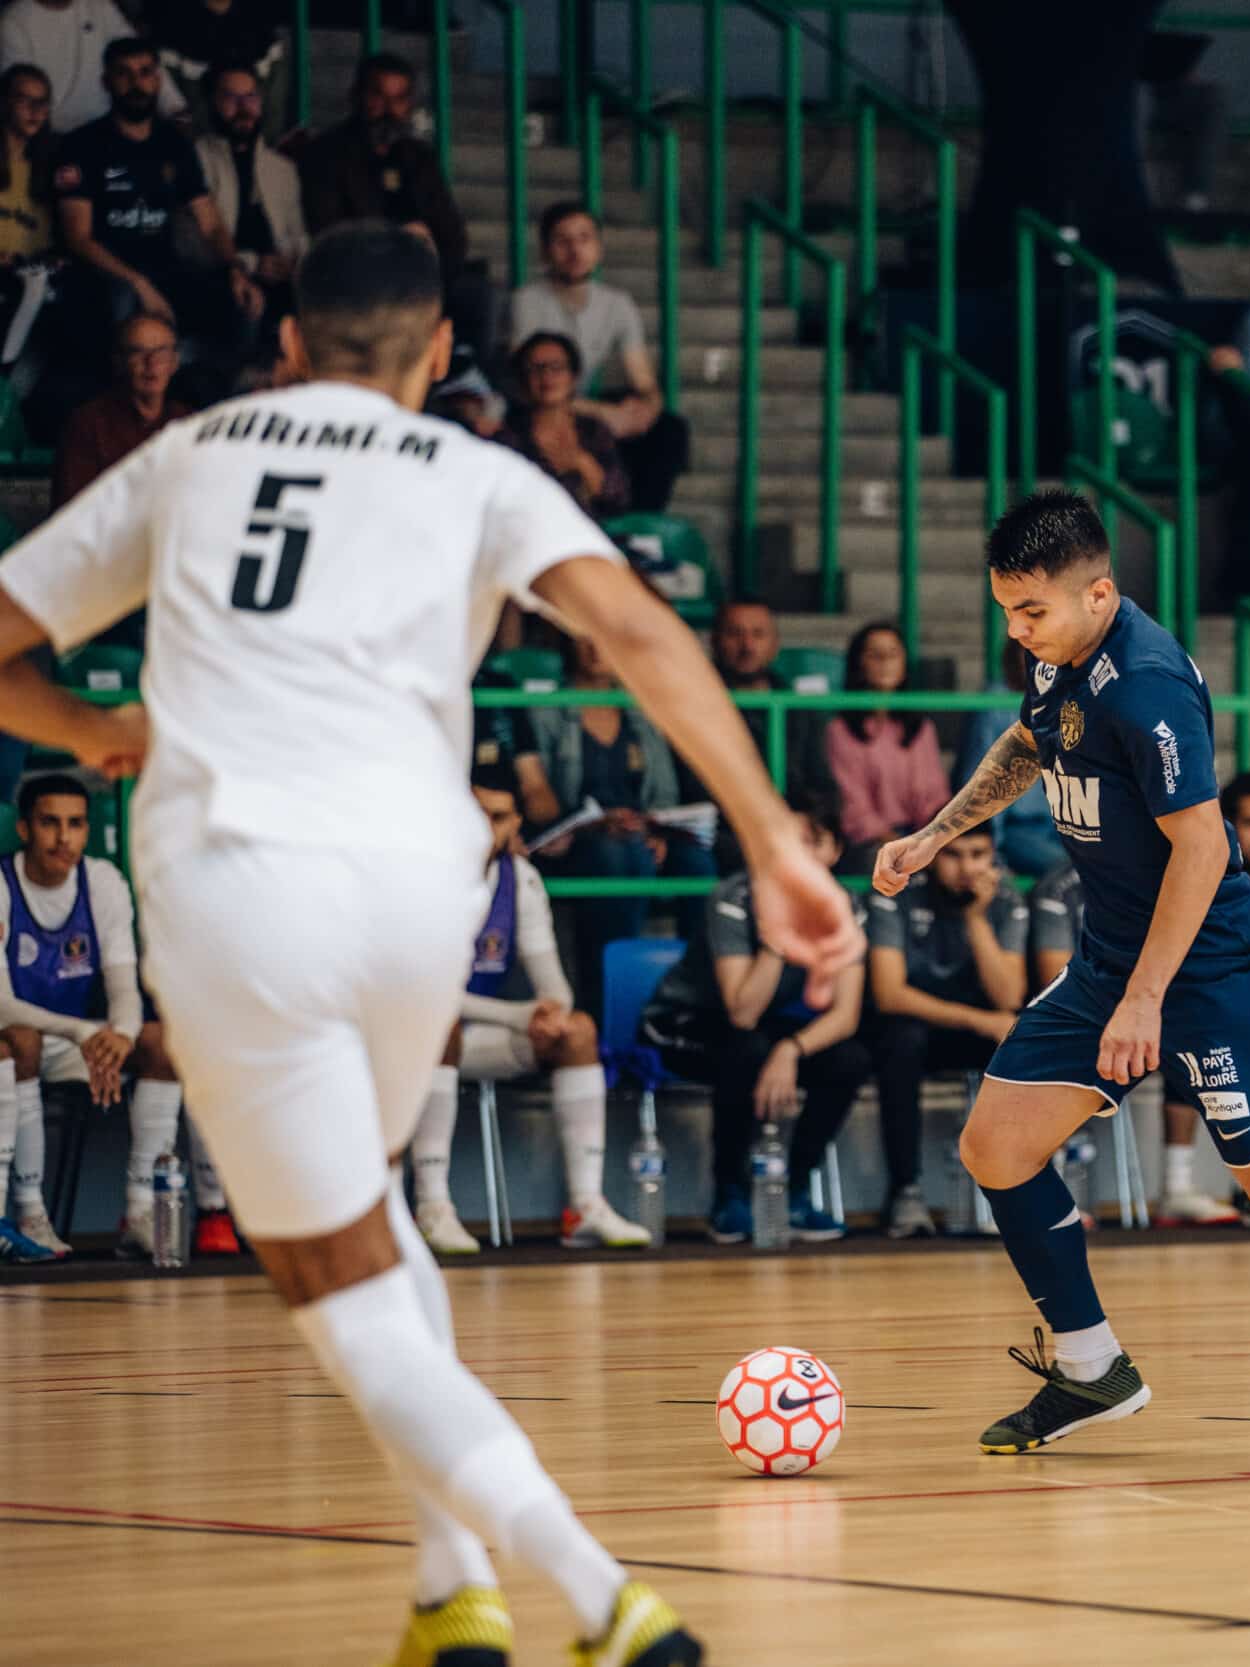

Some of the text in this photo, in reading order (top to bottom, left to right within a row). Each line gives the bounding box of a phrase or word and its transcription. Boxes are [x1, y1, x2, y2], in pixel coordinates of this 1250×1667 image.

[231, 471, 324, 614] 5
[1155, 738, 1177, 795] Métropole
[1167, 735, 1182, 777] Nantes
[1202, 1053, 1234, 1070] PAYS
[1204, 1071, 1240, 1088] LOIRE
